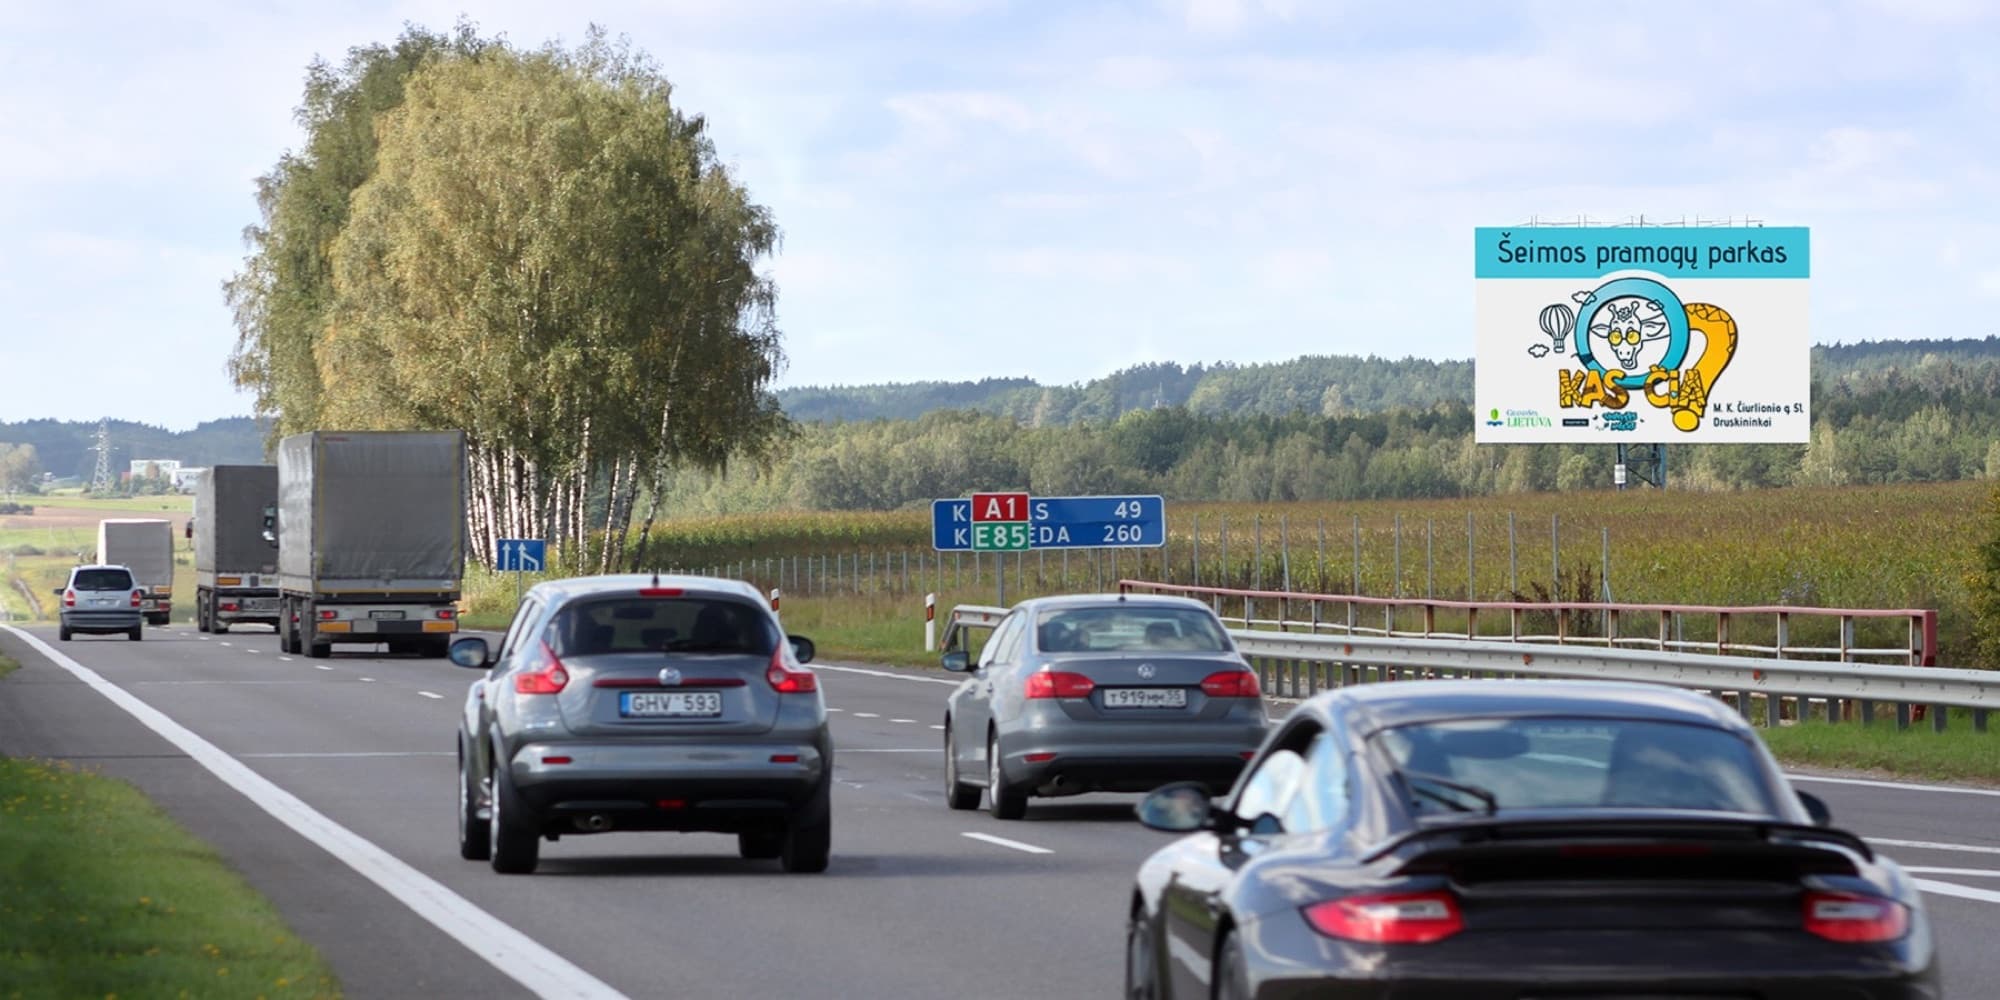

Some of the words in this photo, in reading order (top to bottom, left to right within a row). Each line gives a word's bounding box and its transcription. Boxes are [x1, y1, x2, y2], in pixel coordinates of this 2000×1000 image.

[1498, 232, 1587, 263] Šeimos
[1597, 243, 1698, 269] pramogų
[1708, 240, 1788, 269] parkas
[1558, 368, 1630, 410] KAS
[1737, 400, 1782, 413] Čiurlionio
[1507, 416, 1552, 428] LIETUVA
[1713, 416, 1772, 428] Druskininkai
[985, 497, 1016, 520] A1
[1114, 501, 1142, 519] 49
[975, 525, 1026, 548] E85
[1103, 524, 1142, 543] 260
[631, 695, 673, 712] GHV
[683, 695, 719, 711] 593
